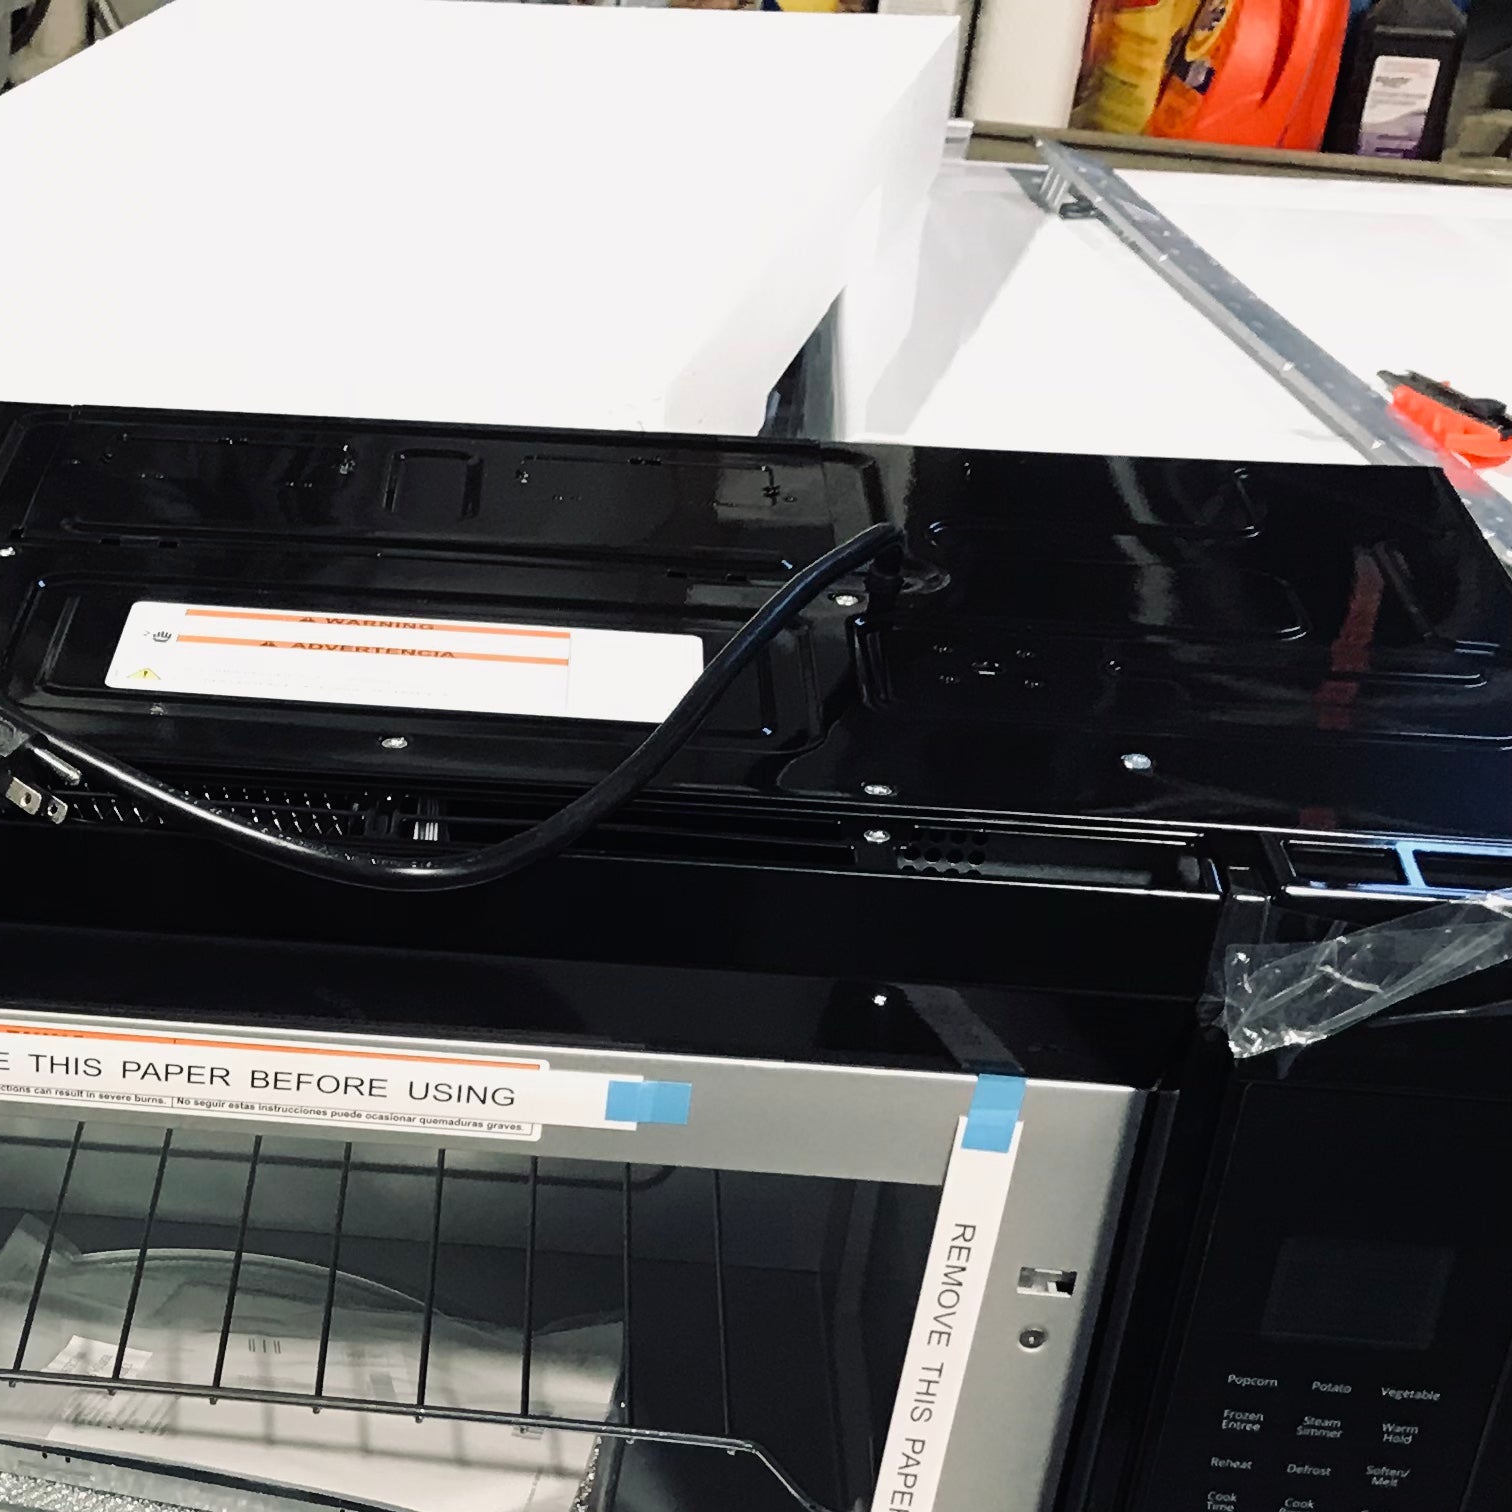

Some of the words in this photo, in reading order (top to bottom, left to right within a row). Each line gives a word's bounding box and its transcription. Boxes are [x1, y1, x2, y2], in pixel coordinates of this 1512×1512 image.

[326, 618, 435, 630] WARNING
[291, 642, 456, 658] ADVERTENCIA
[28, 1052, 103, 1078] THIS
[121, 1060, 231, 1087] PAPER
[250, 1069, 389, 1099] BEFORE
[408, 1080, 515, 1107] USING
[34, 1087, 52, 1096] can
[54, 1087, 84, 1099] result
[86, 1090, 96, 1099] in
[98, 1092, 133, 1102] severe
[134, 1093, 167, 1105] burns.
[176, 1096, 191, 1106] No
[193, 1097, 225, 1110] seguir
[227, 1100, 255, 1111] estas
[258, 1103, 328, 1118] instrucciones
[330, 1109, 363, 1120] puede
[365, 1111, 417, 1123] ocasionar
[419, 1115, 484, 1129] quemaduras
[486, 1121, 524, 1133] graves.
[927, 1222, 977, 1348] REMOVE
[1228, 1374, 1278, 1387] Popcorn
[909, 1362, 944, 1423] THIS
[1311, 1381, 1352, 1394] Potato
[1381, 1387, 1441, 1401] Vegetable
[1223, 1409, 1264, 1422] Frozen
[1302, 1415, 1341, 1428] Steam
[1296, 1425, 1343, 1439] Simmer
[1382, 1423, 1419, 1435] Warm
[1382, 1432, 1413, 1445] Hold
[1210, 1456, 1253, 1470] Reheat
[1286, 1464, 1332, 1477] Defrost
[1207, 1491, 1238, 1503] Cook
[1284, 1497, 1315, 1510] Cook
[1206, 1501, 1235, 1512] Time
